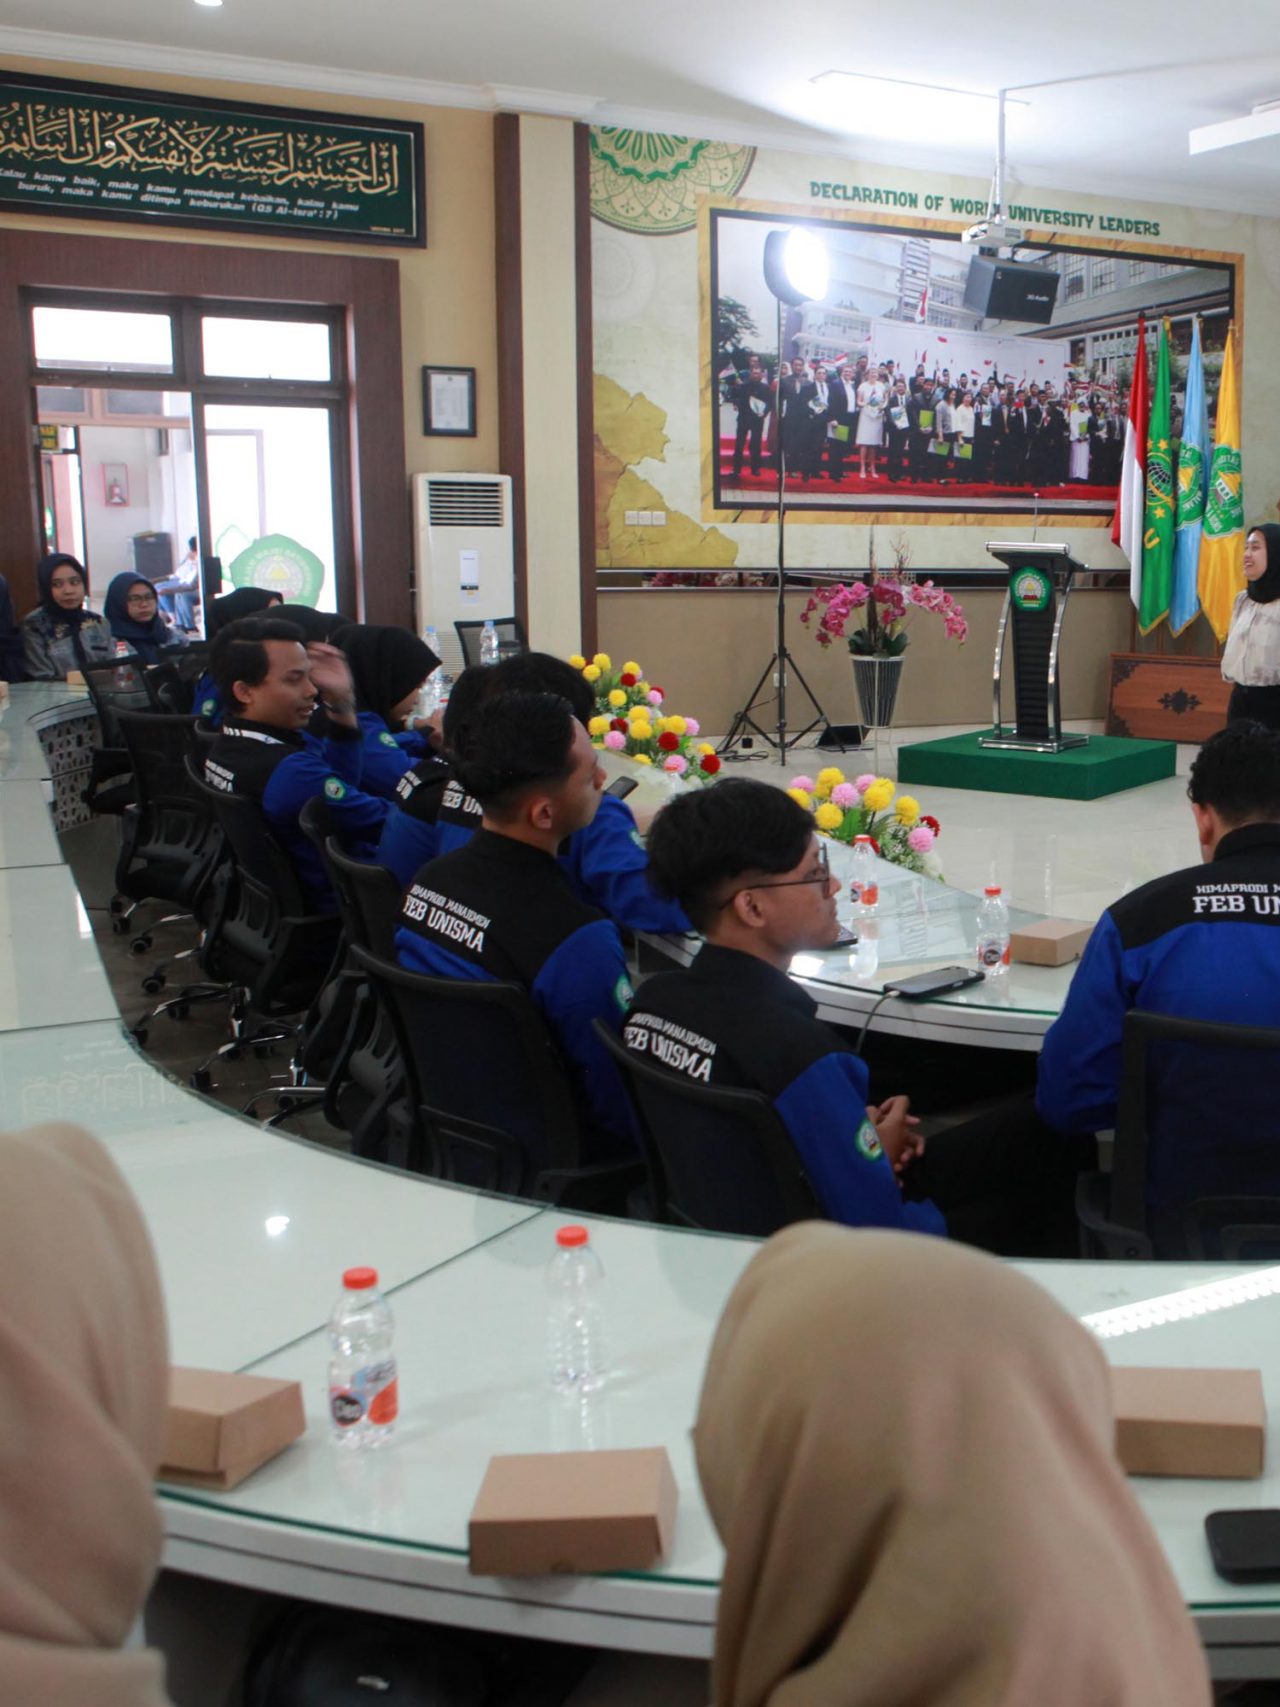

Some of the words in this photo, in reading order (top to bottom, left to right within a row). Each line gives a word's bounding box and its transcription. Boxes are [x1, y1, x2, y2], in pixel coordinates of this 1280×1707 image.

[34, 171, 66, 183] kamu
[73, 175, 100, 187] baik,
[107, 180, 140, 191] maka
[146, 183, 177, 194] kamu
[183, 188, 235, 200] mendapat
[331, 201, 360, 211] kamu
[61, 187, 94, 197] maka
[101, 189, 133, 200] kamu
[140, 193, 181, 206] ditimpa
[188, 198, 246, 211] keburukan
[810, 181, 919, 208] DECLARATION
[924, 195, 944, 211] OF
[1008, 205, 1095, 229] UNIVERSITY
[1099, 215, 1160, 236] LEADERS
[1192, 894, 1245, 914] FEB
[1196, 884, 1269, 894] HIMAPRODI
[427, 907, 484, 952] UNISMA
[651, 1032, 712, 1082] UNISMA
